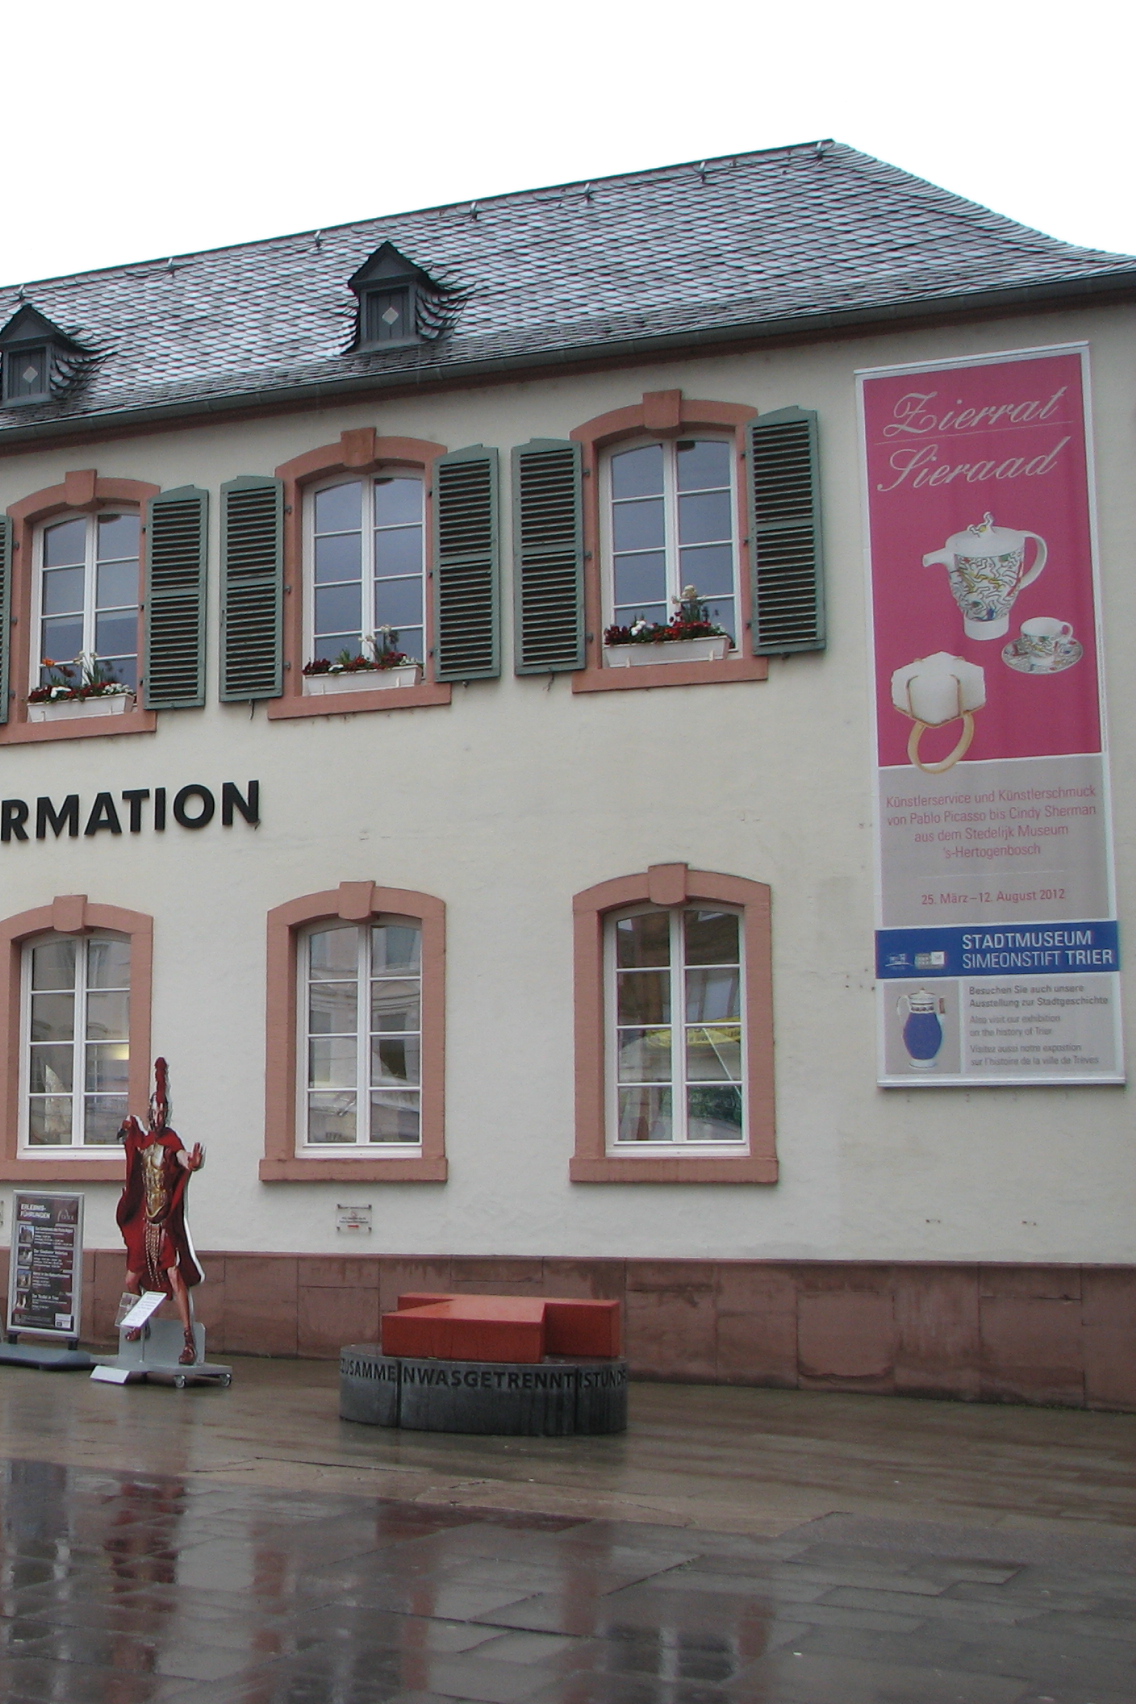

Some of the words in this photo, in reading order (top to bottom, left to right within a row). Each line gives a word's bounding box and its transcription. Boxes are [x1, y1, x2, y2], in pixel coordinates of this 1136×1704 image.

[883, 386, 1069, 437] Zierrat
[876, 435, 1071, 492] Sieraad
[886, 791, 971, 808] Künstlerservice
[975, 790, 995, 804] und
[998, 784, 1096, 801] Künstlerschmuck
[887, 816, 907, 826] von
[910, 812, 941, 825] Pablo
[944, 810, 986, 823] Picasso
[989, 808, 1005, 820] bis
[1009, 806, 1040, 820] Cindy
[1045, 804, 1097, 817] Sherman
[914, 832, 934, 843] aus
[937, 829, 962, 841] dem
[965, 826, 1014, 841] Stedelijk
[1018, 824, 1069, 837] Museum
[921, 894, 934, 905] 25.
[996, 889, 1036, 903] August
[1039, 889, 1065, 900] 2012
[962, 930, 1092, 949] STADTMUSEUM
[962, 950, 1061, 969] SIMEONSTIFT
[1065, 948, 1113, 965] TRIER
[969, 986, 1011, 995] Besuchen
[1014, 985, 1027, 994] Sie
[1030, 985, 1051, 994] auch
[1054, 984, 1084, 993] unsere
[969, 998, 1019, 1008] Ausstellung
[1037, 995, 1109, 1007] Stadtgeschichte
